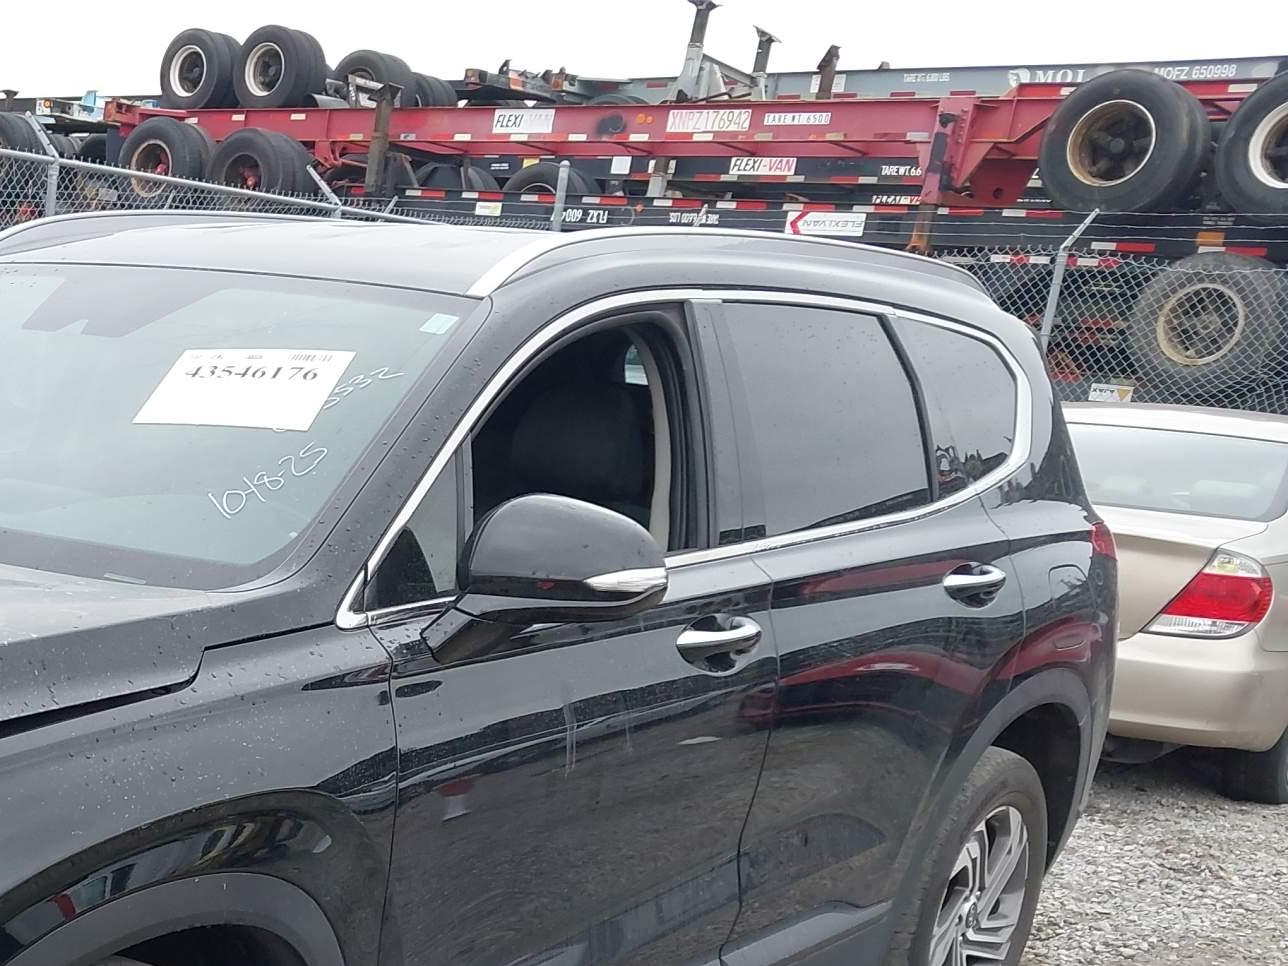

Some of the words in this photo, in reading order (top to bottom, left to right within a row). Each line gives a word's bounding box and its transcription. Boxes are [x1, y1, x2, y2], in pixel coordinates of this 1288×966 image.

[1192, 63, 1237, 79] 650998
[494, 113, 524, 129] FLEXI
[731, 158, 795, 173] FLEXI-VAN
[586, 210, 608, 224] FLXZ
[185, 365, 320, 381] 43546176
